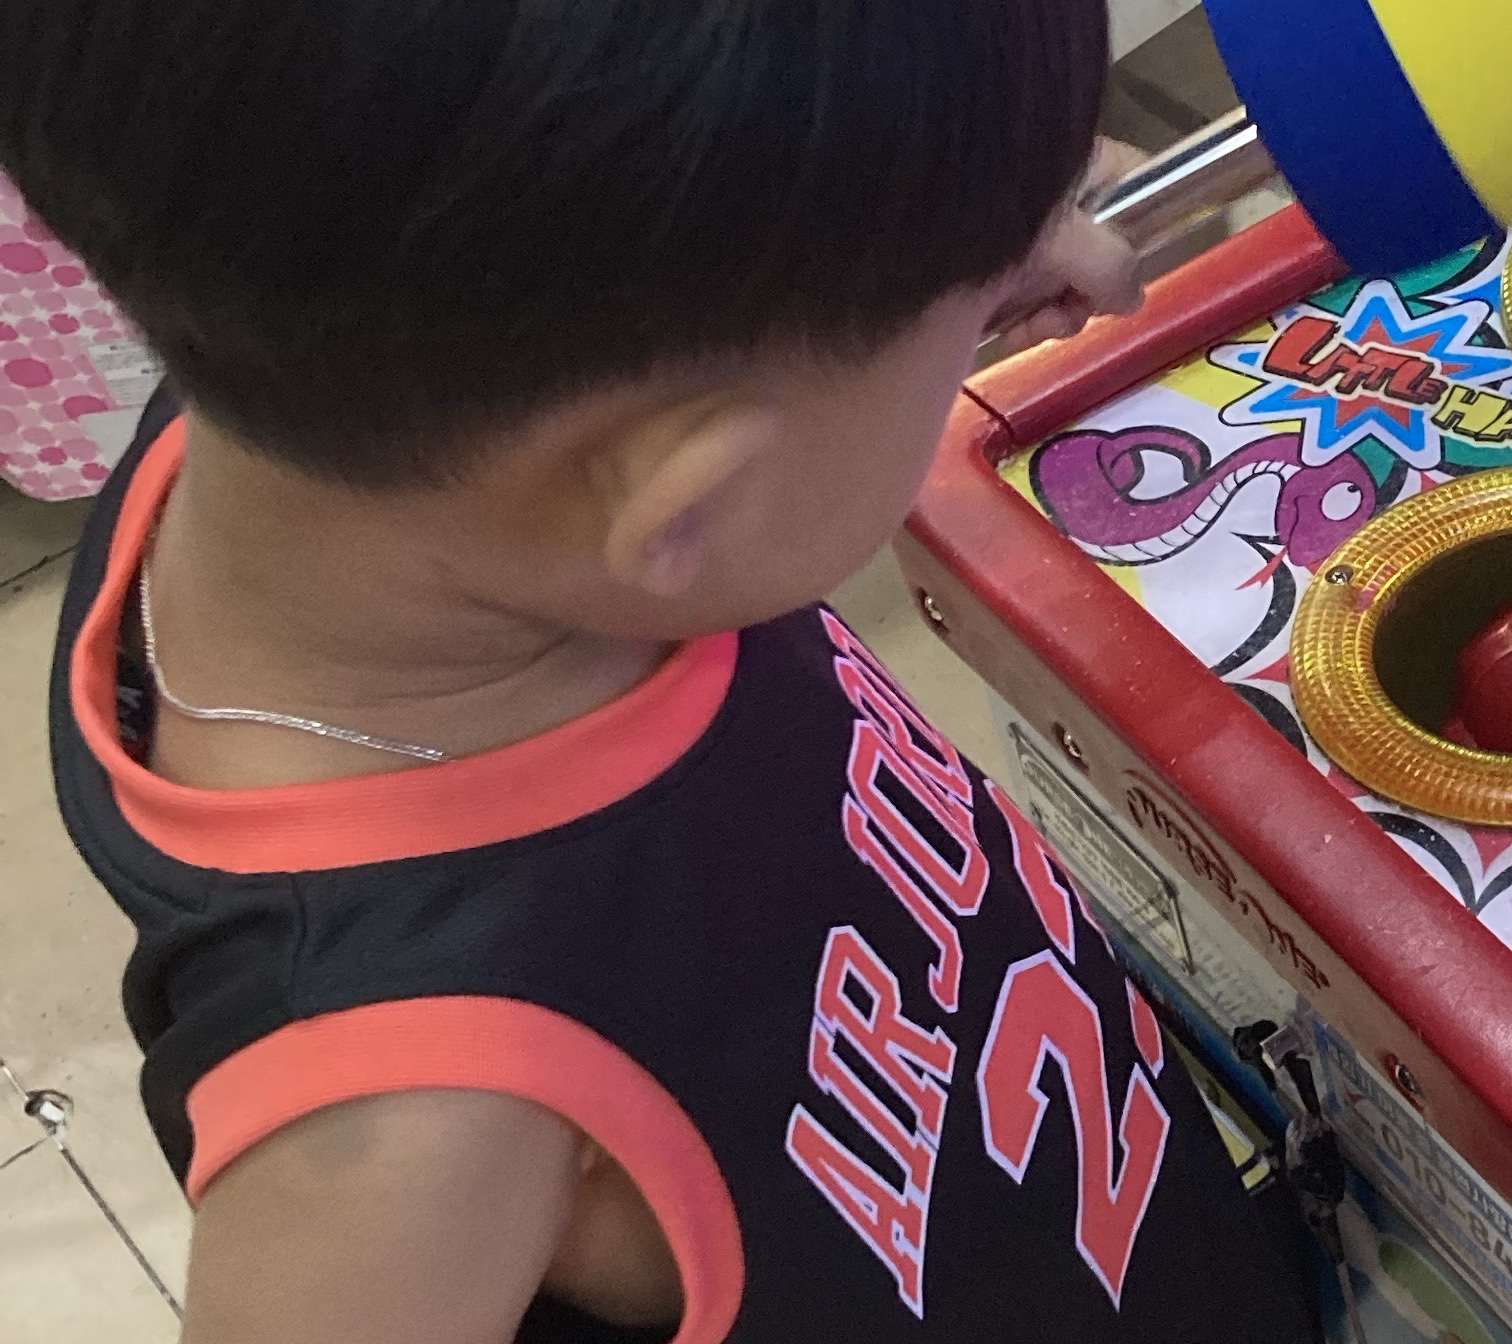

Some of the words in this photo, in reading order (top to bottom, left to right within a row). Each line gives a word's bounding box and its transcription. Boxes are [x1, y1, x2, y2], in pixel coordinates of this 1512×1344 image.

[1263, 316, 1449, 404] LITTLE
[819, 608, 990, 1013] JOR
[785, 924, 957, 1320] AIR
